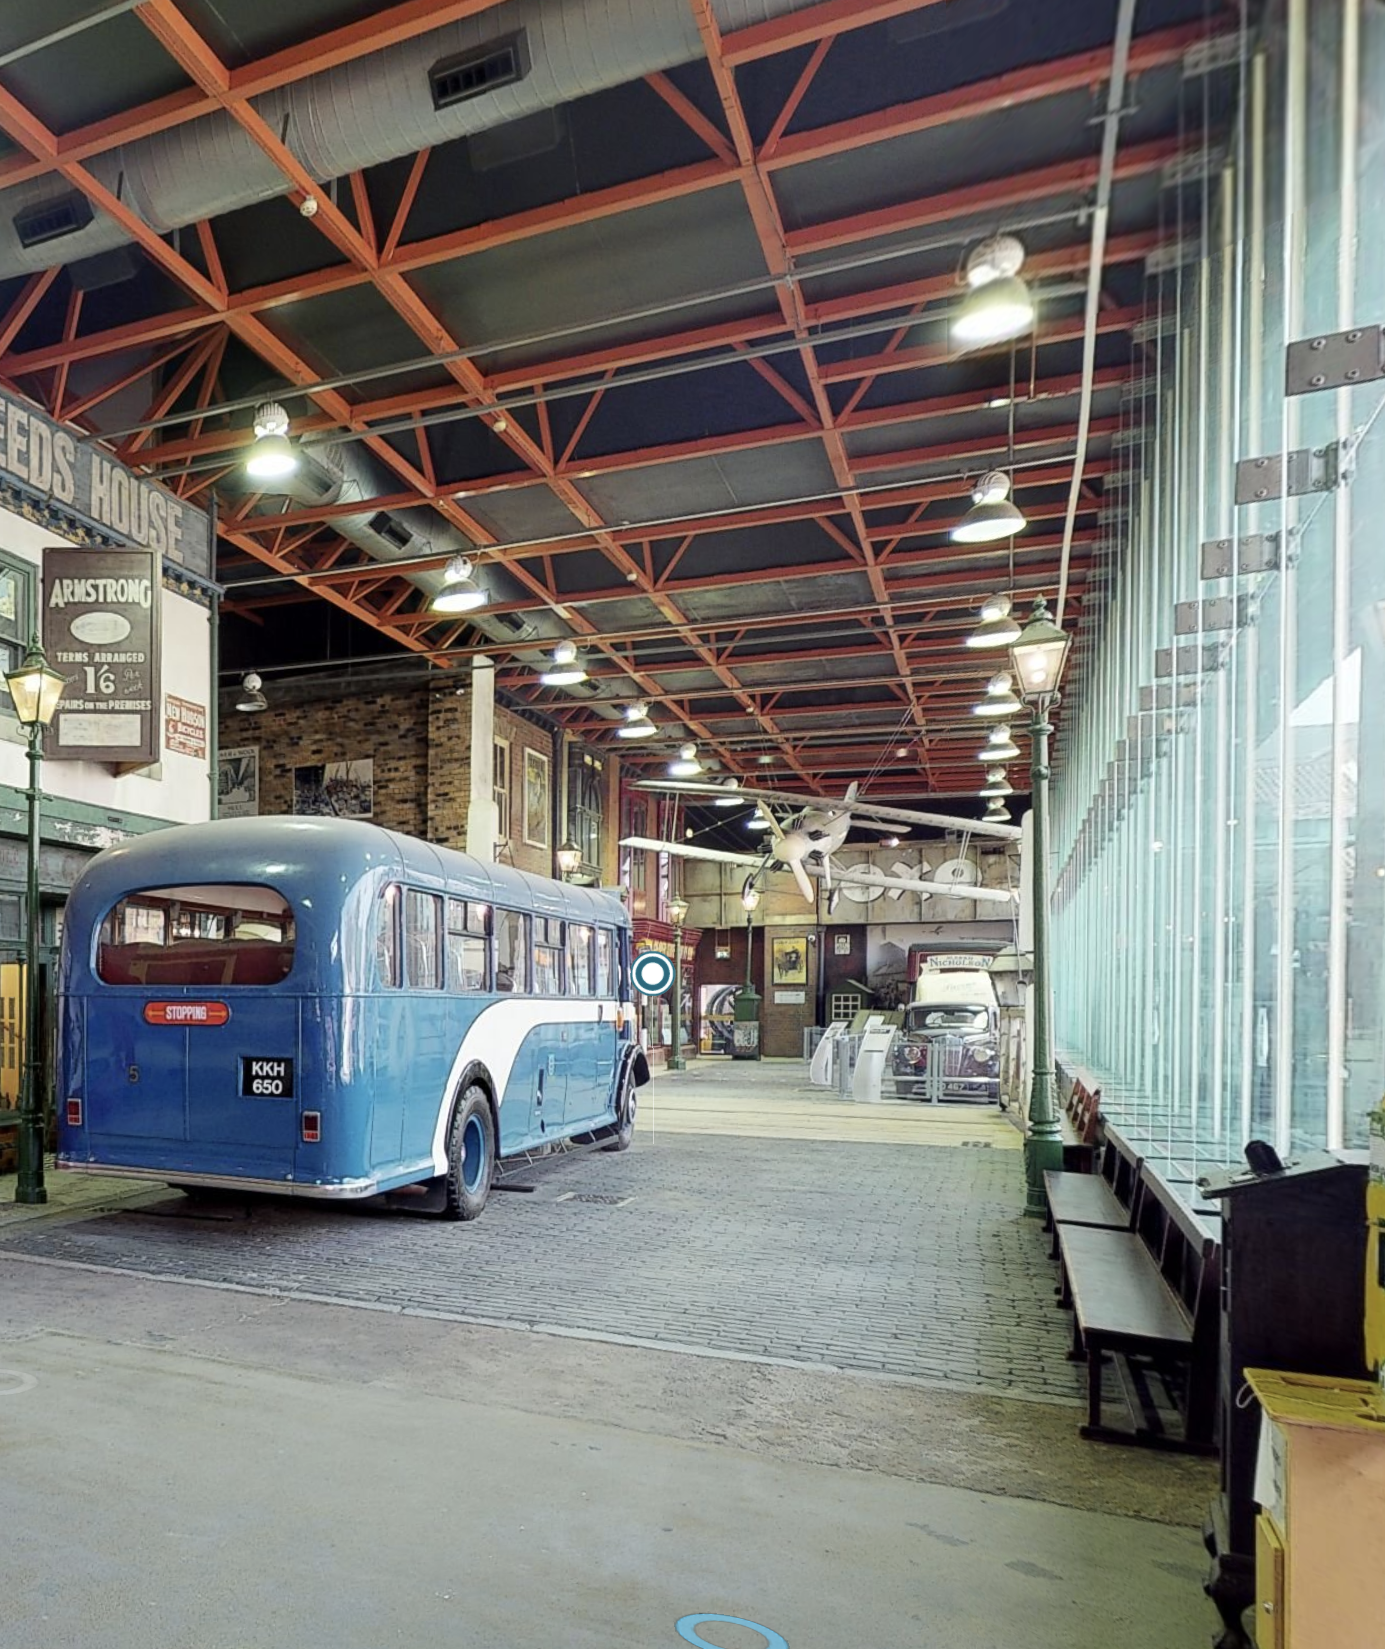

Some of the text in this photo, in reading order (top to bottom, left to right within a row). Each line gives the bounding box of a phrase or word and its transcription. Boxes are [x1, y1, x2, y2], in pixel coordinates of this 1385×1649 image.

[90, 452, 185, 565] HOUSE
[49, 578, 152, 608] ARMSTRONG
[56, 652, 145, 663] TERMS ARRANGED
[108, 700, 152, 711] PREMISES
[165, 702, 181, 722] NEW
[165, 1005, 207, 1021] STOPPING
[129, 1065, 139, 1083] 5
[251, 1061, 285, 1077] KKH
[252, 1079, 283, 1095] 650
